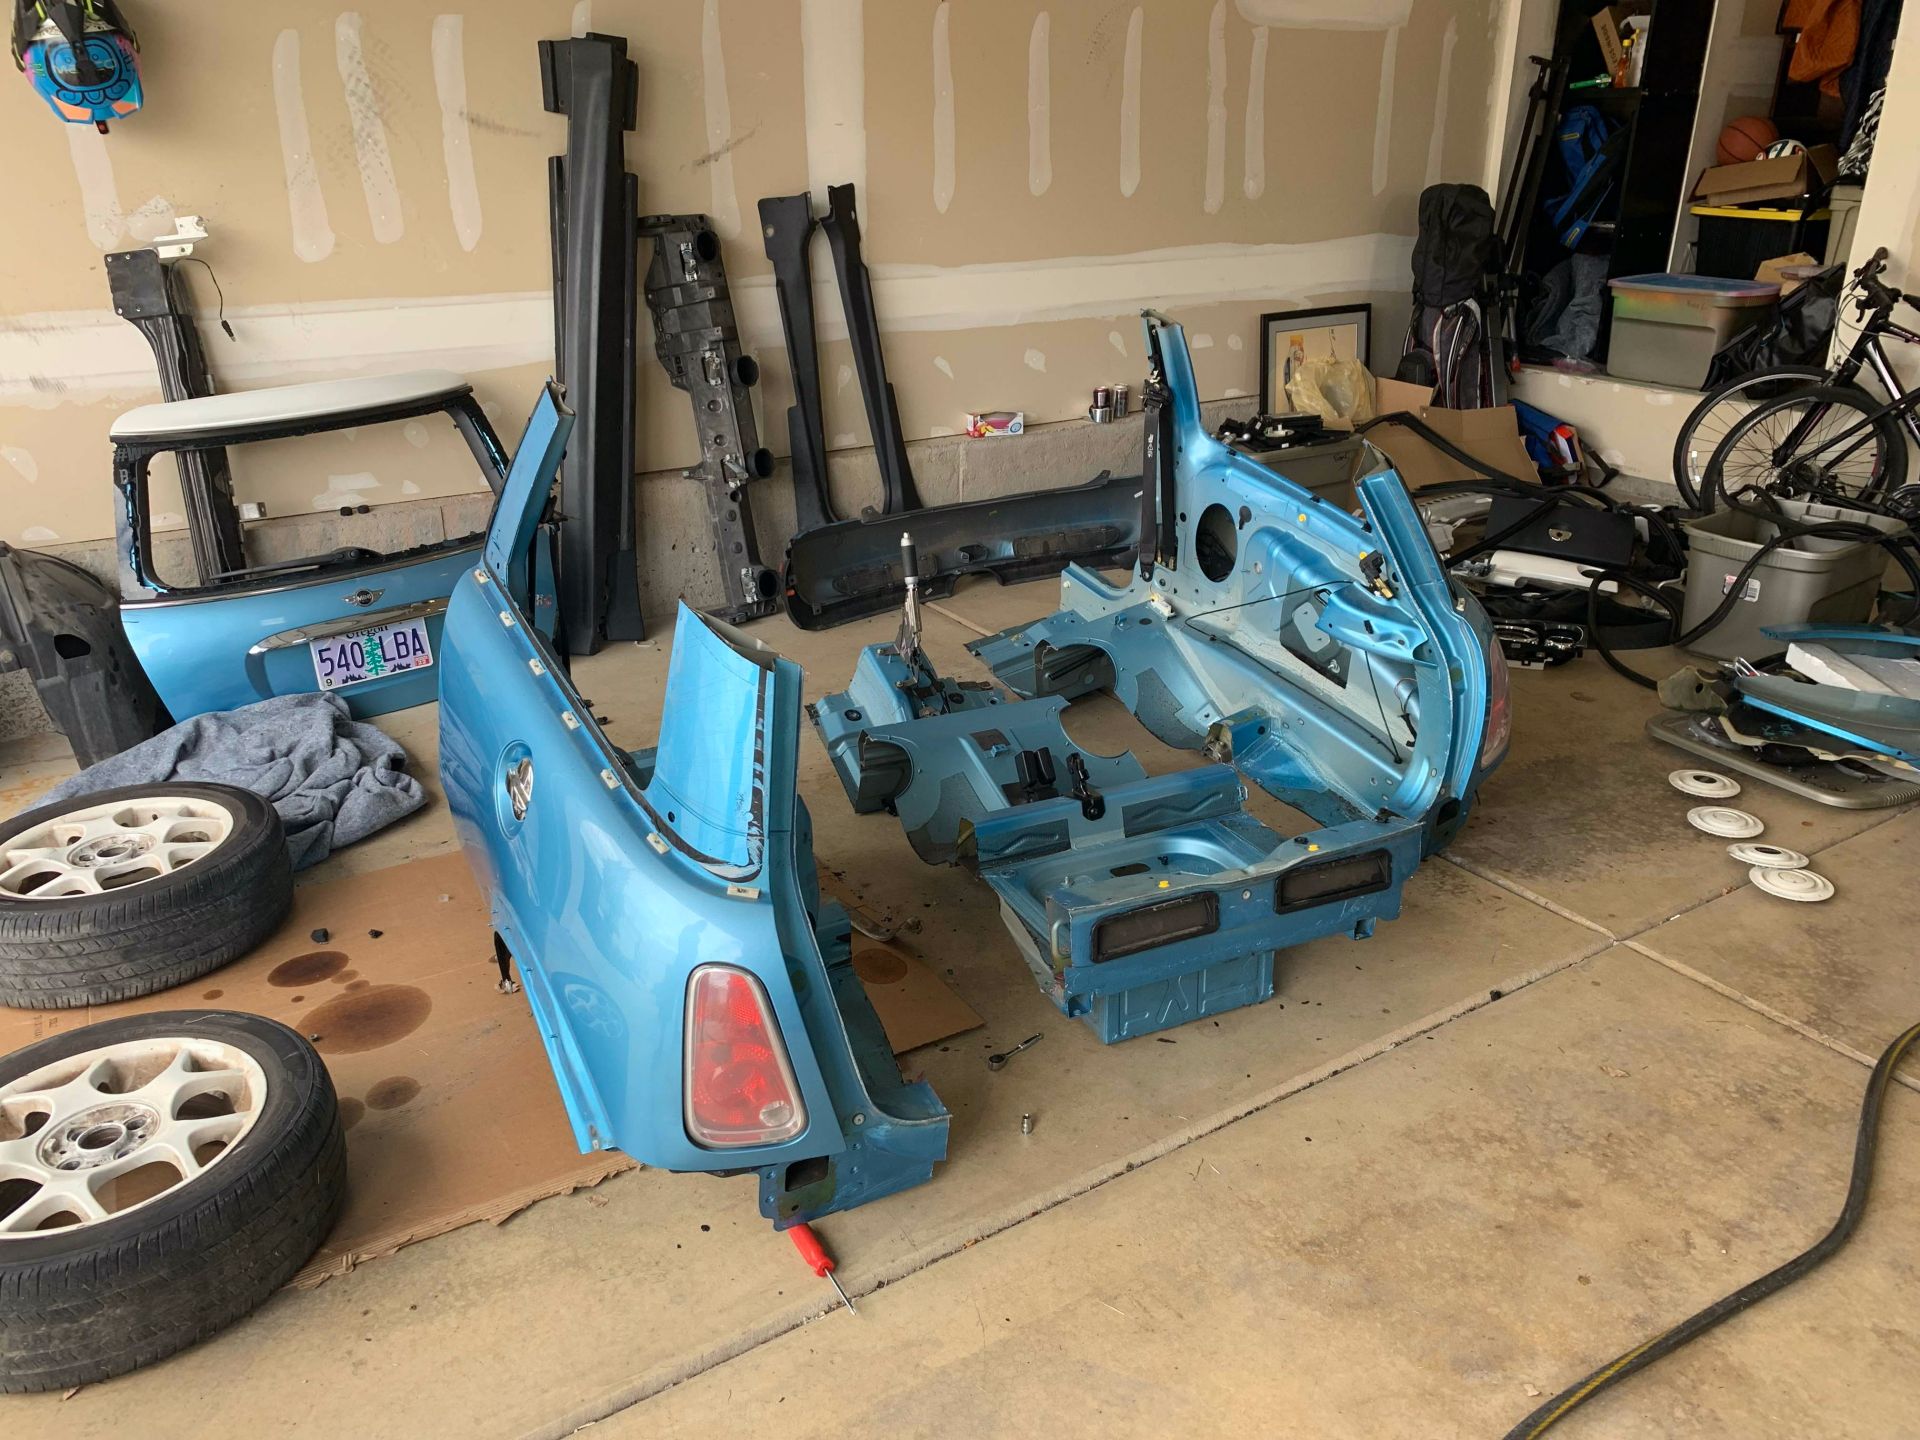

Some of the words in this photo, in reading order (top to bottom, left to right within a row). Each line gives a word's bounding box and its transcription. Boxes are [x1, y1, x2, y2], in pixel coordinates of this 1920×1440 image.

[318, 641, 365, 677] 540
[378, 628, 425, 663] LBA
[326, 678, 333, 687] 9
